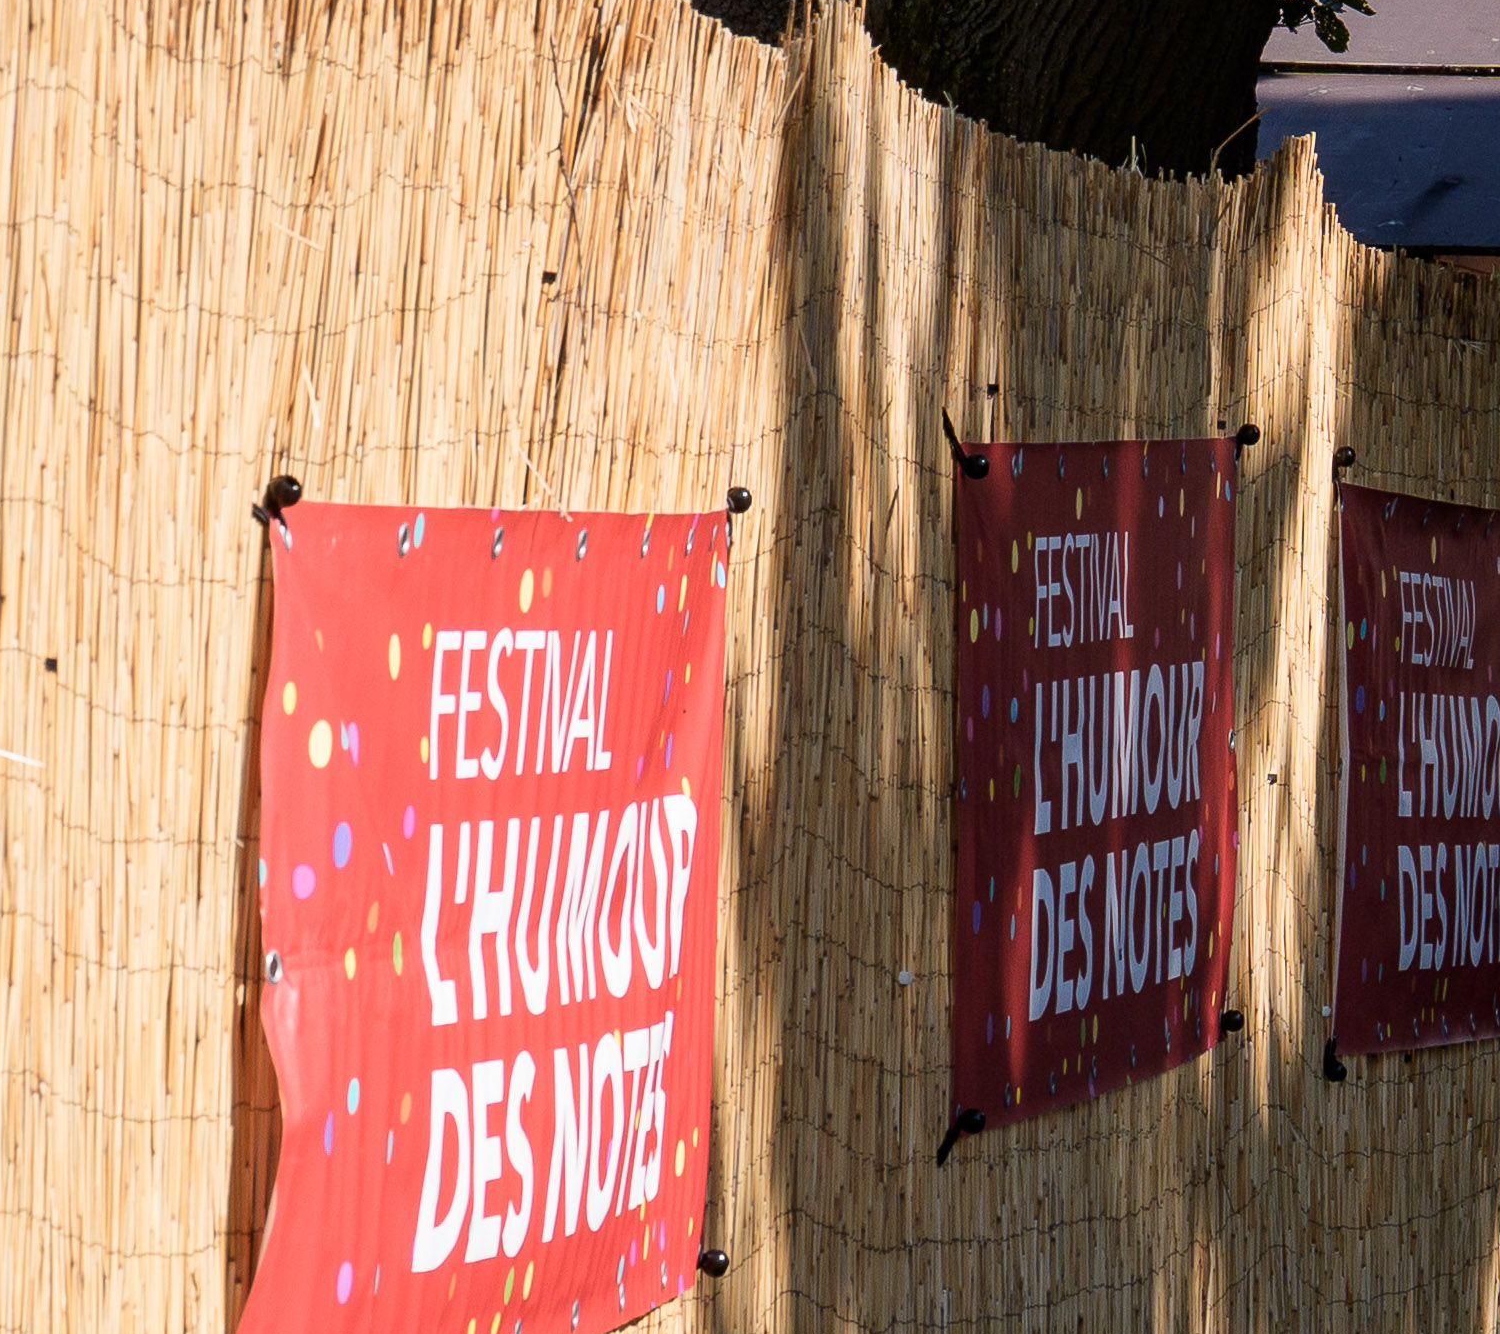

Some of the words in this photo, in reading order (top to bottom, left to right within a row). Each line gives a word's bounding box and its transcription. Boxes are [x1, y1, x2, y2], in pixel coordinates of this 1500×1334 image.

[1034, 531, 1134, 649] FESTIVAL
[1399, 571, 1476, 670] FESTIVAL
[429, 627, 613, 781] FESTIVAL
[1033, 661, 1205, 836] L'HUMOUR
[421, 794, 698, 1026] L'HUMOUR
[1027, 854, 1095, 1022] DES
[1102, 828, 1200, 1000] NOTES
[1397, 841, 1449, 971] DES
[412, 1050, 535, 1272] DES
[541, 1010, 674, 1243] NOTES
